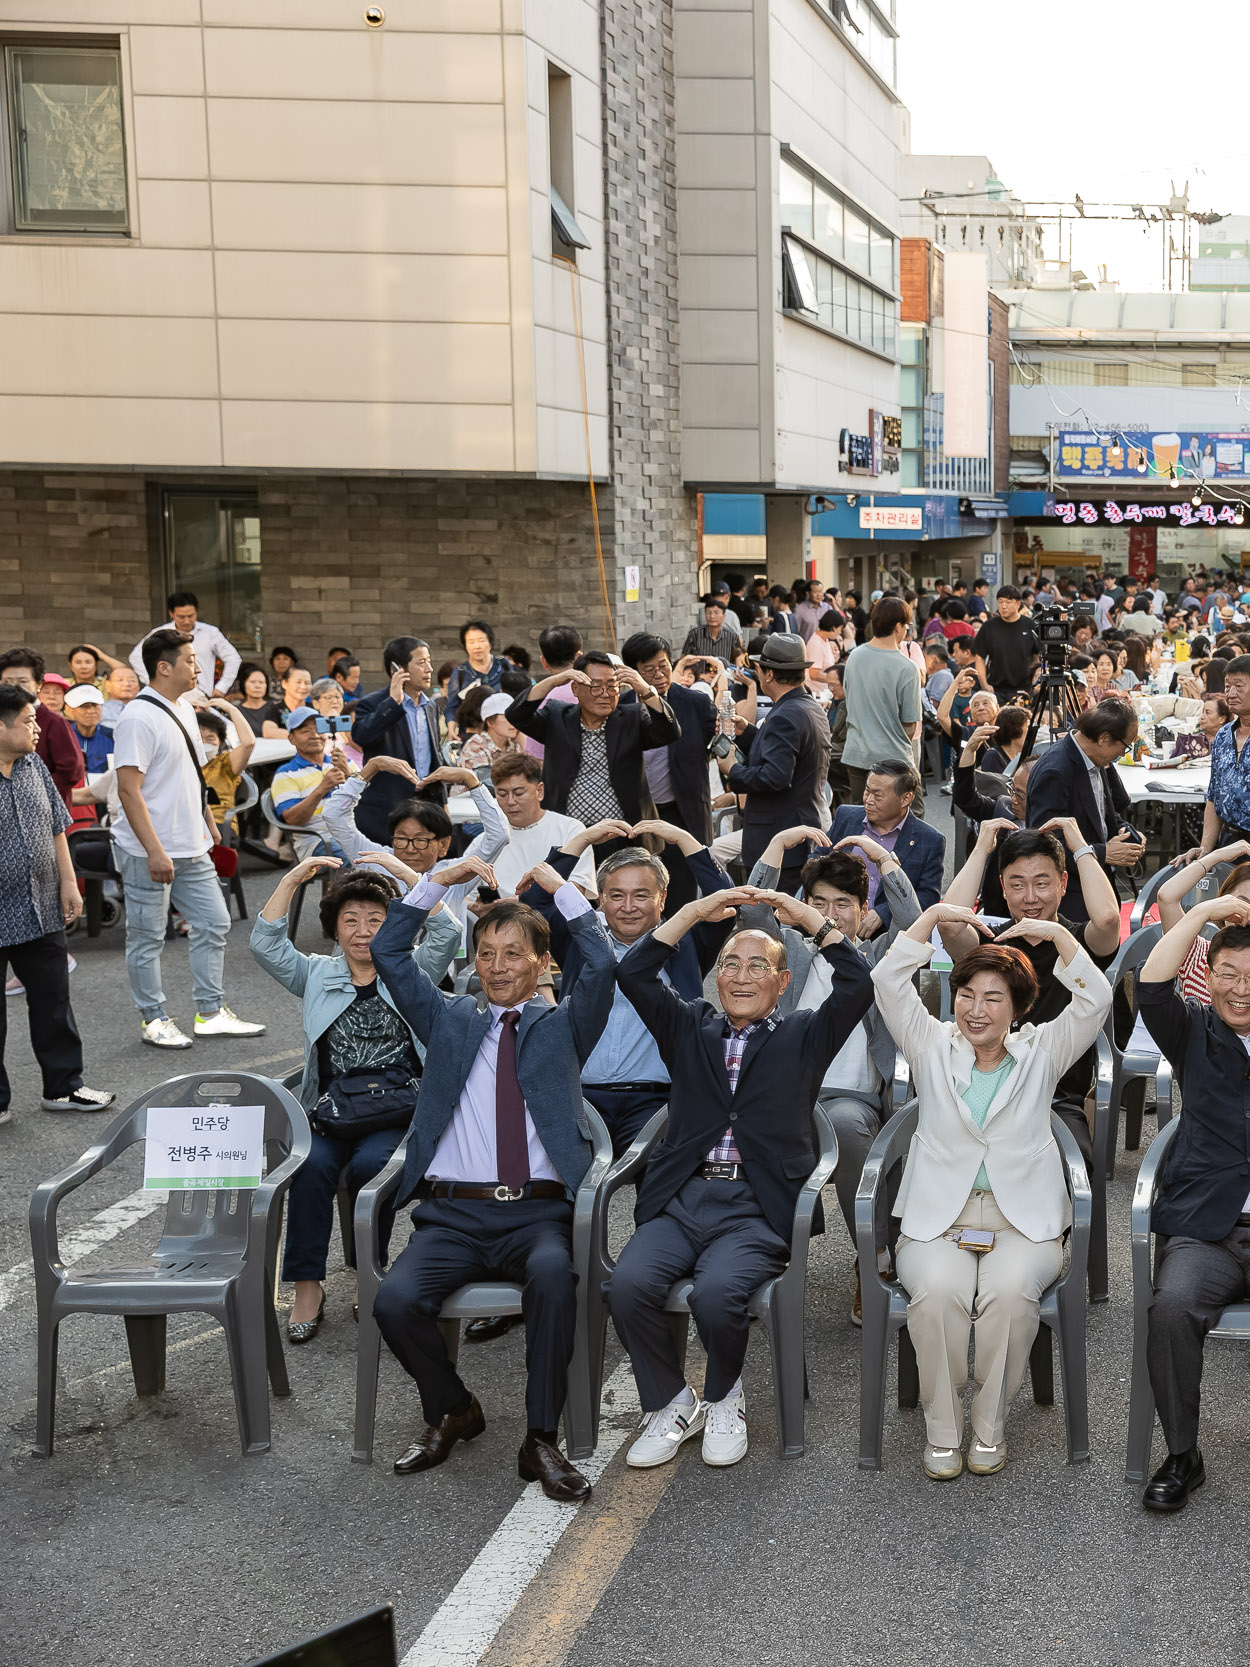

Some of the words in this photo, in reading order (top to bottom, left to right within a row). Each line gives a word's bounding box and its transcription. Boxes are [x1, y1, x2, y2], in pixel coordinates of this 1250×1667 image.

[863, 512, 920, 526] 주차관리실
[192, 1116, 230, 1131] 민주당
[168, 1145, 212, 1162] 전병주
[215, 1150, 248, 1161] 시의원님
